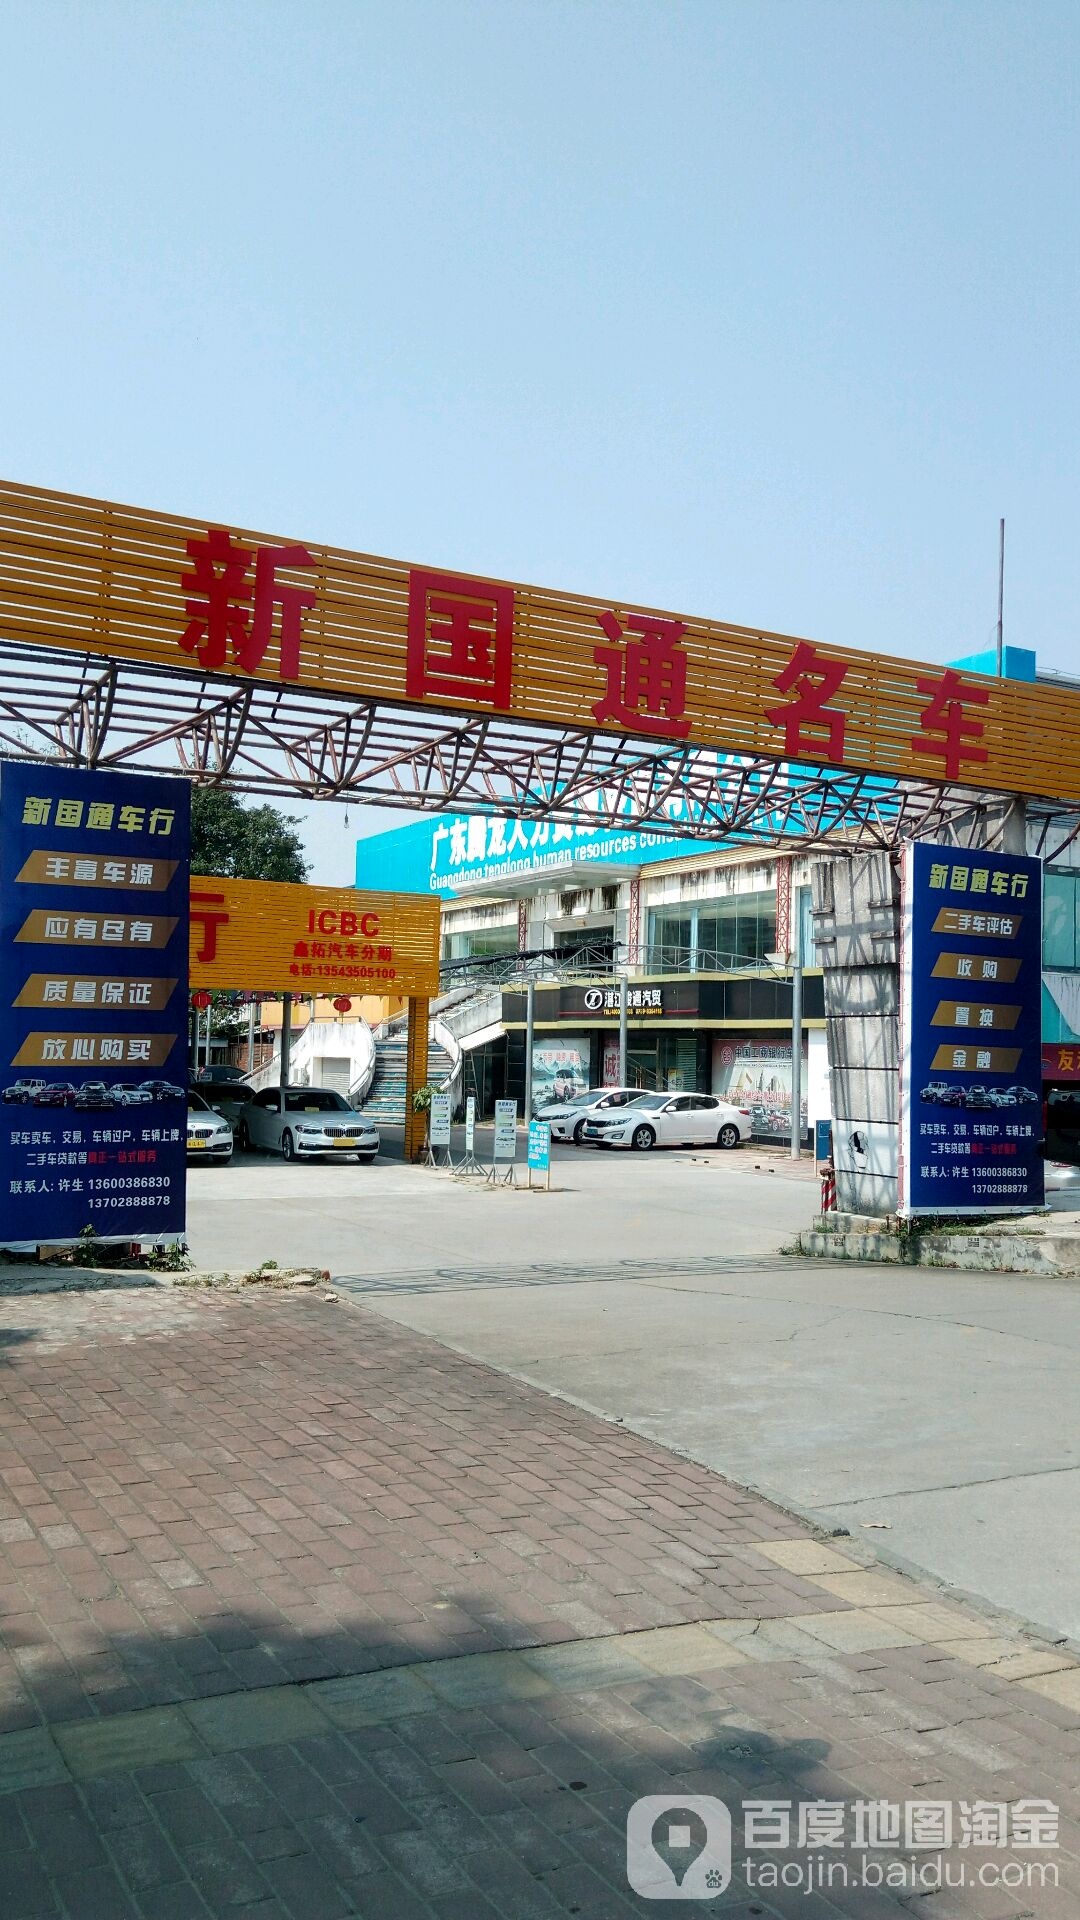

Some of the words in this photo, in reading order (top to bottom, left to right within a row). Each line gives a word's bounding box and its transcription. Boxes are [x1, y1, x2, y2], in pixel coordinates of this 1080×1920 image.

[178, 529, 990, 780] 新国通名车
[22, 797, 175, 835] 新国通车行
[532, 849, 572, 868] human
[574, 834, 637, 861] resources
[45, 857, 154, 885] 丰富车源
[928, 863, 1029, 898] 新国通车行
[44, 917, 153, 942] 应有尽有
[308, 909, 380, 937] ICBC
[944, 912, 1014, 936] 二手车评估
[957, 958, 998, 979] 收购
[42, 980, 153, 1005] 质量保证
[41, 1038, 152, 1061] 放心购买
[952, 1049, 991, 1069] 金融
[88, 1177, 171, 1190] 13600386830
[971, 1167, 1028, 1177] 13600386830
[971, 1184, 1028, 1194] 13702888878
[88, 1196, 171, 1209] 13702888878
